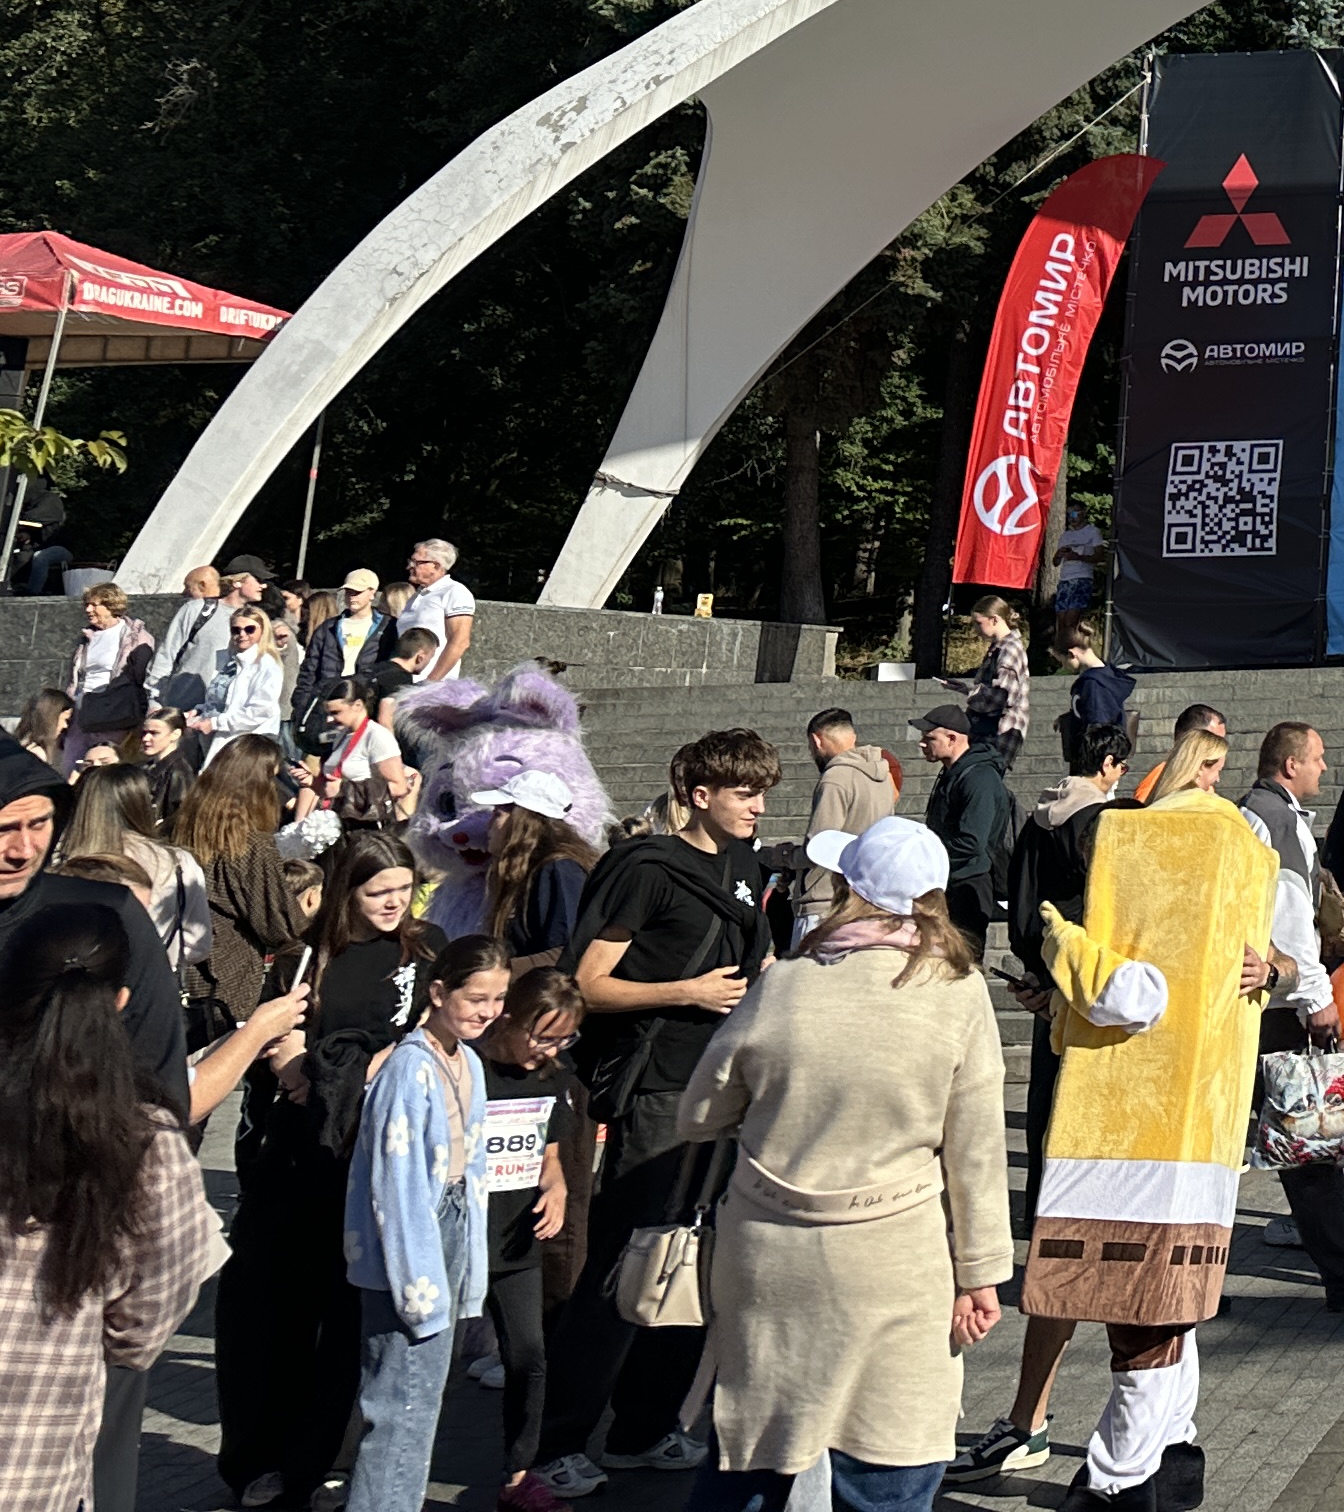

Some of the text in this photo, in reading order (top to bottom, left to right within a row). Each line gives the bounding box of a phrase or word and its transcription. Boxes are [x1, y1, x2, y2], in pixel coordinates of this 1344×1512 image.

[1064, 240, 1097, 319] МІСТЕЧКО
[1163, 256, 1310, 283] MITSUBISHI
[82, 282, 285, 332] DRAGUKRAINE.COM DRIFTUKR
[1181, 282, 1289, 307] MOTORS
[1002, 232, 1076, 441] АВТОМИР
[1204, 342, 1305, 359] АВТОМИР
[495, 1164, 525, 1176] RUN
